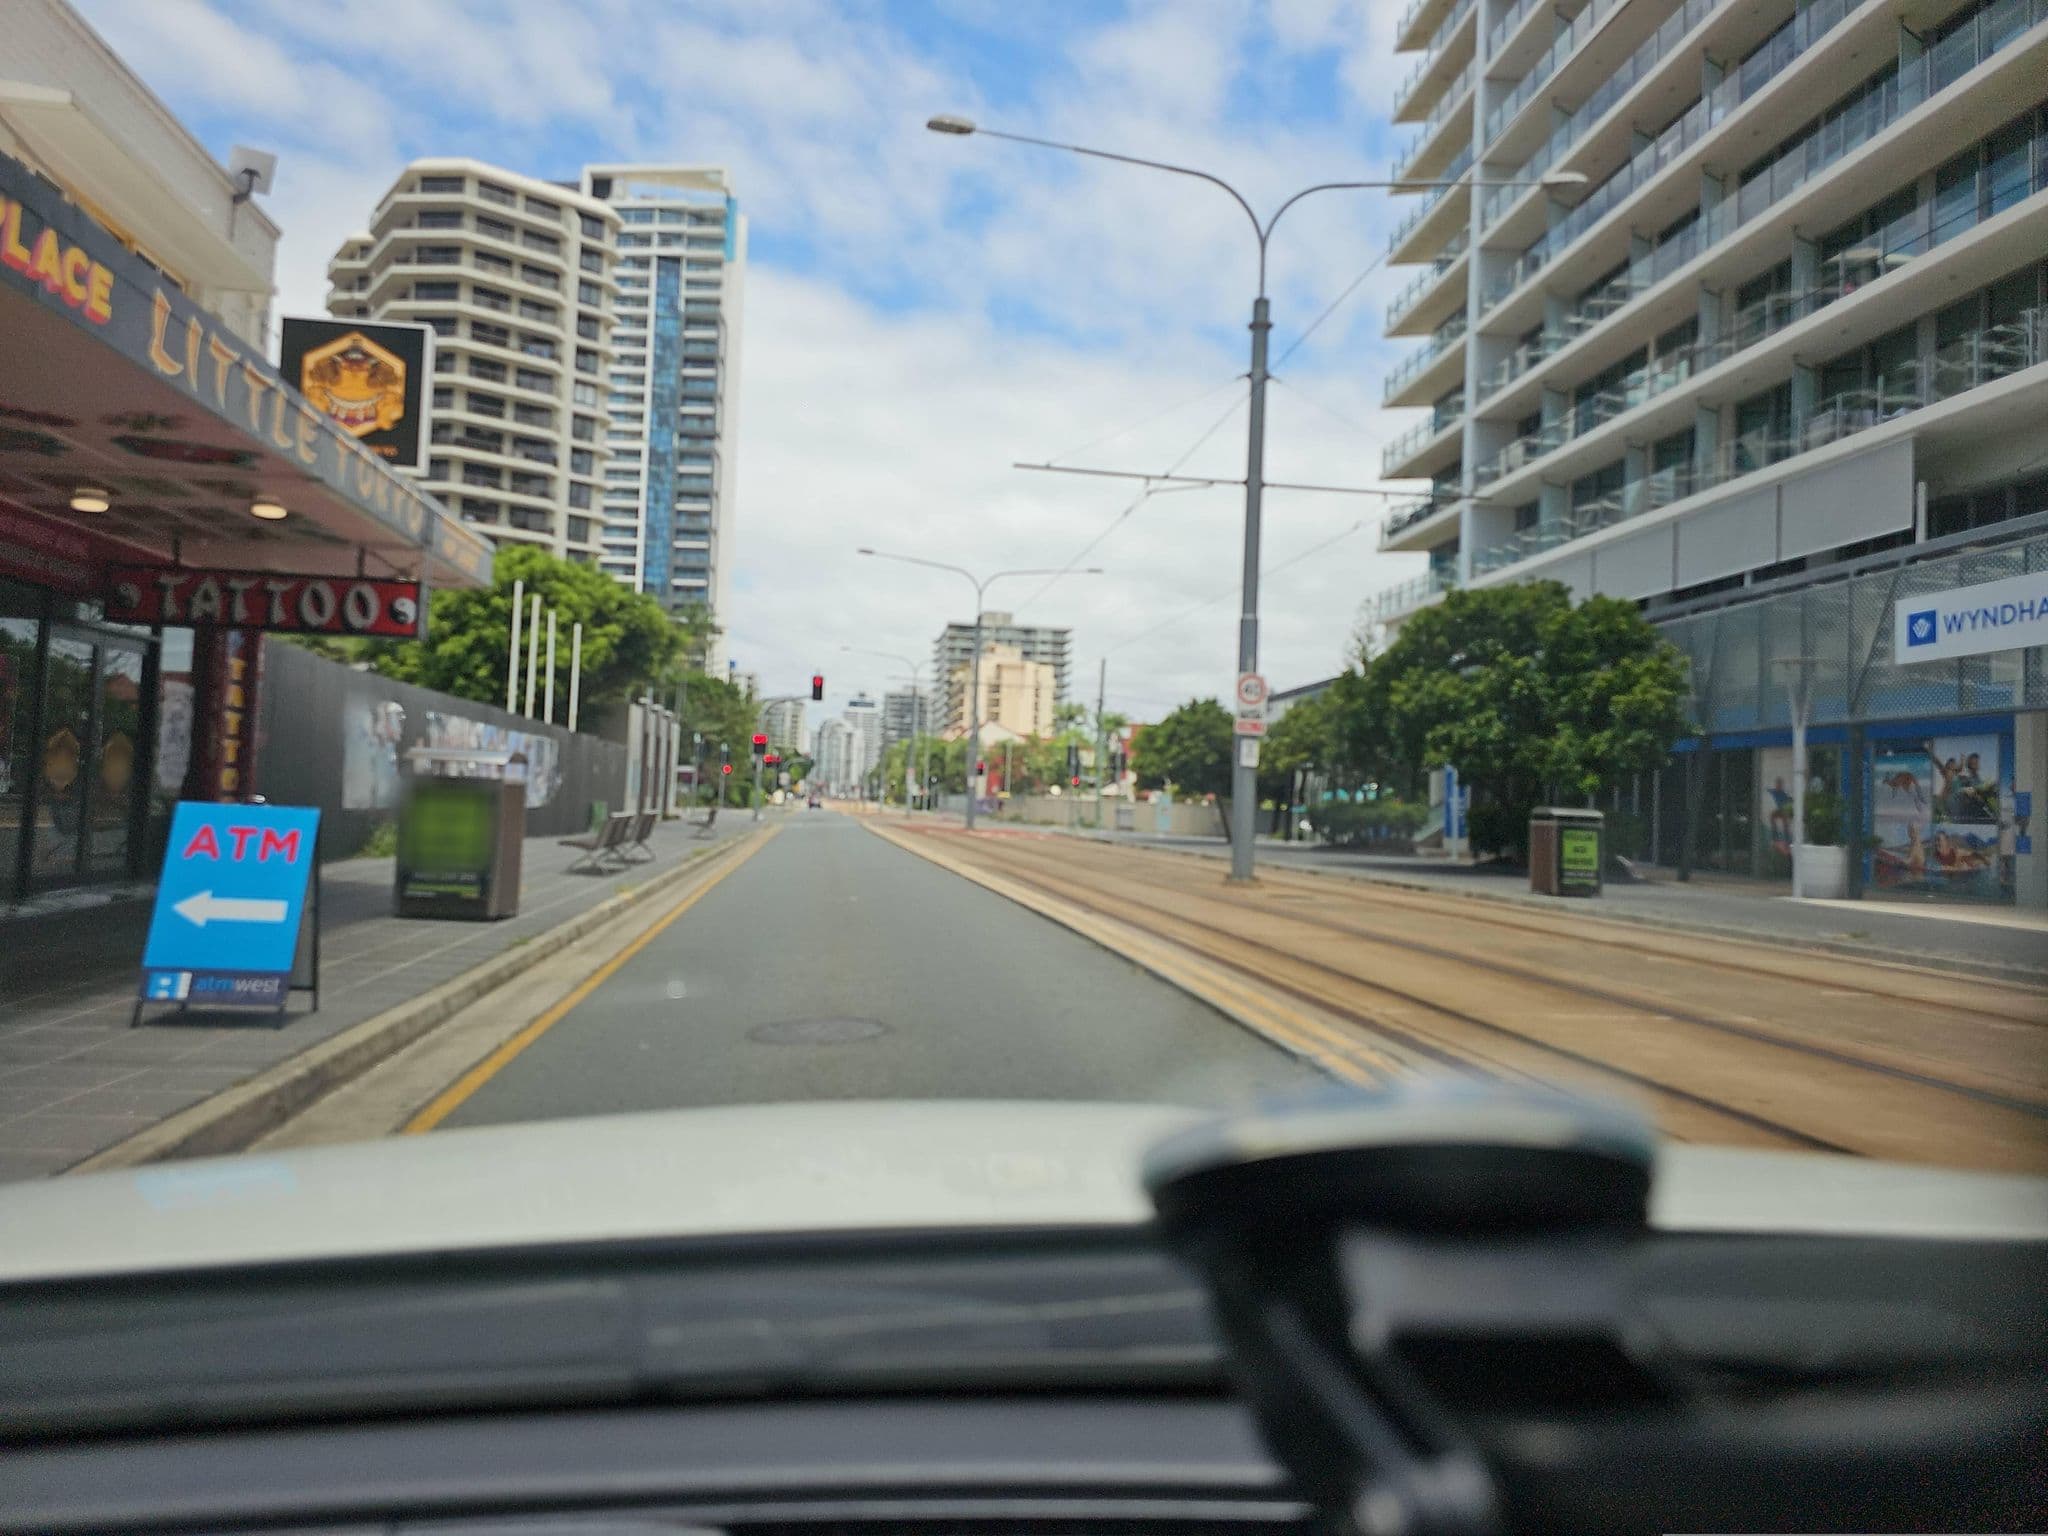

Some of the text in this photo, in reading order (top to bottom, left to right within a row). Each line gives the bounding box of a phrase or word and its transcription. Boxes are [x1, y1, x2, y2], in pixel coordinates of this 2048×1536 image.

[0, 198, 114, 325] LACE
[149, 288, 323, 465] LITTLE
[156, 573, 382, 630] TATTOO
[219, 657, 248, 803] TATTO
[182, 823, 302, 864] ATM
[193, 975, 281, 994] atmwest
